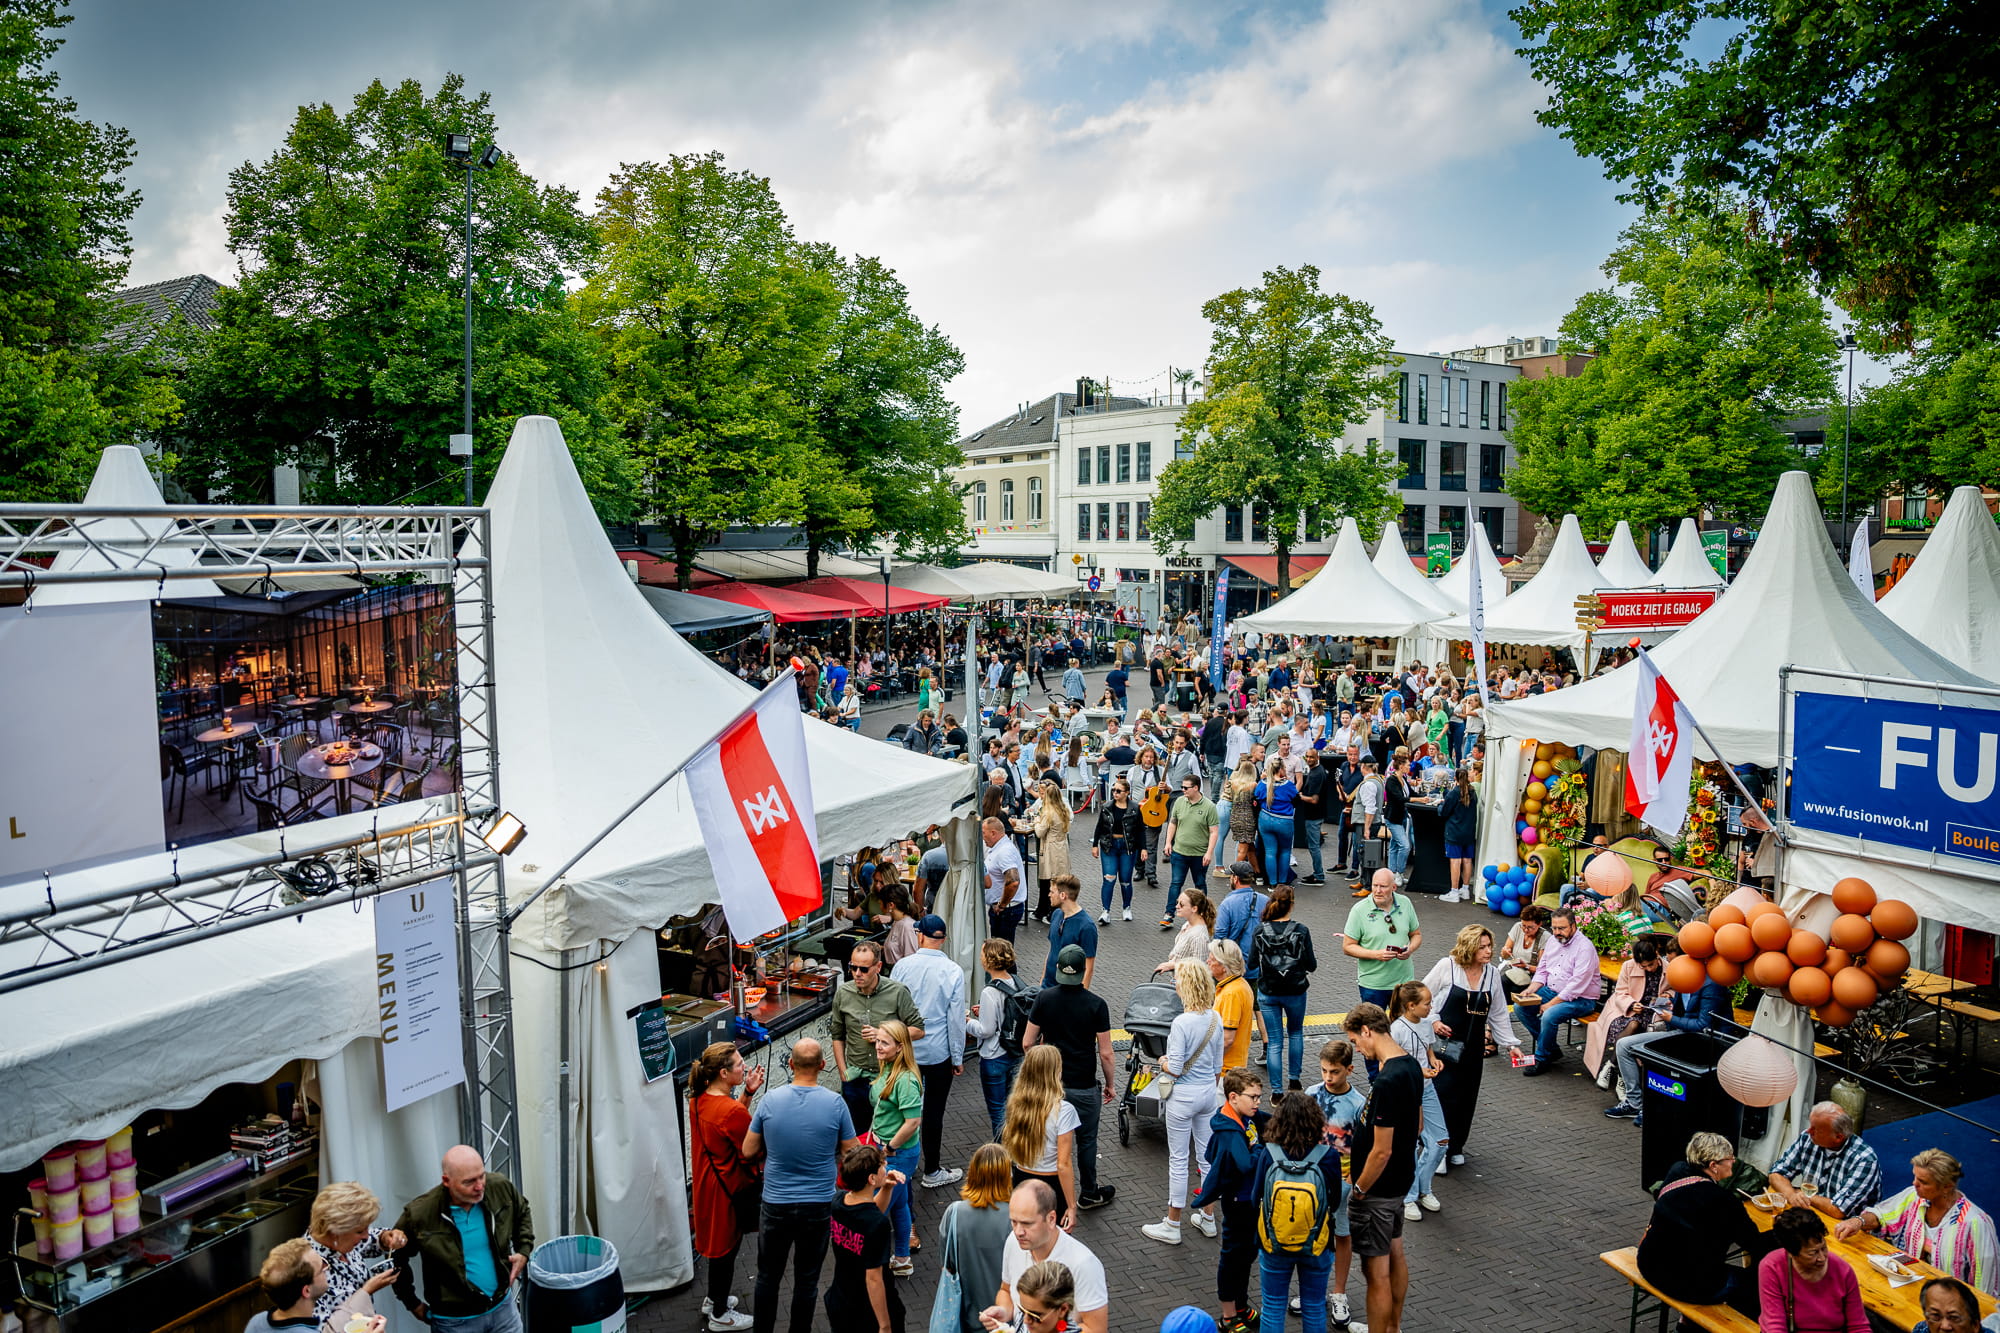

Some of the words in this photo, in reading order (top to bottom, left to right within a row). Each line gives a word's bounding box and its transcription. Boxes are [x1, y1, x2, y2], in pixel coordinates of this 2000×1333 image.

[1165, 556, 1203, 568] MOEKE
[1611, 604, 1642, 617] MOEKE
[1643, 603, 1662, 616] ZIET
[1663, 603, 1672, 615] JE
[1673, 602, 1701, 614] GRAAG
[1879, 720, 1999, 804] FU
[1803, 801, 1929, 833] www.fusionwok.nl
[1952, 831, 2000, 853] Boule
[377, 952, 399, 1044] MENU
